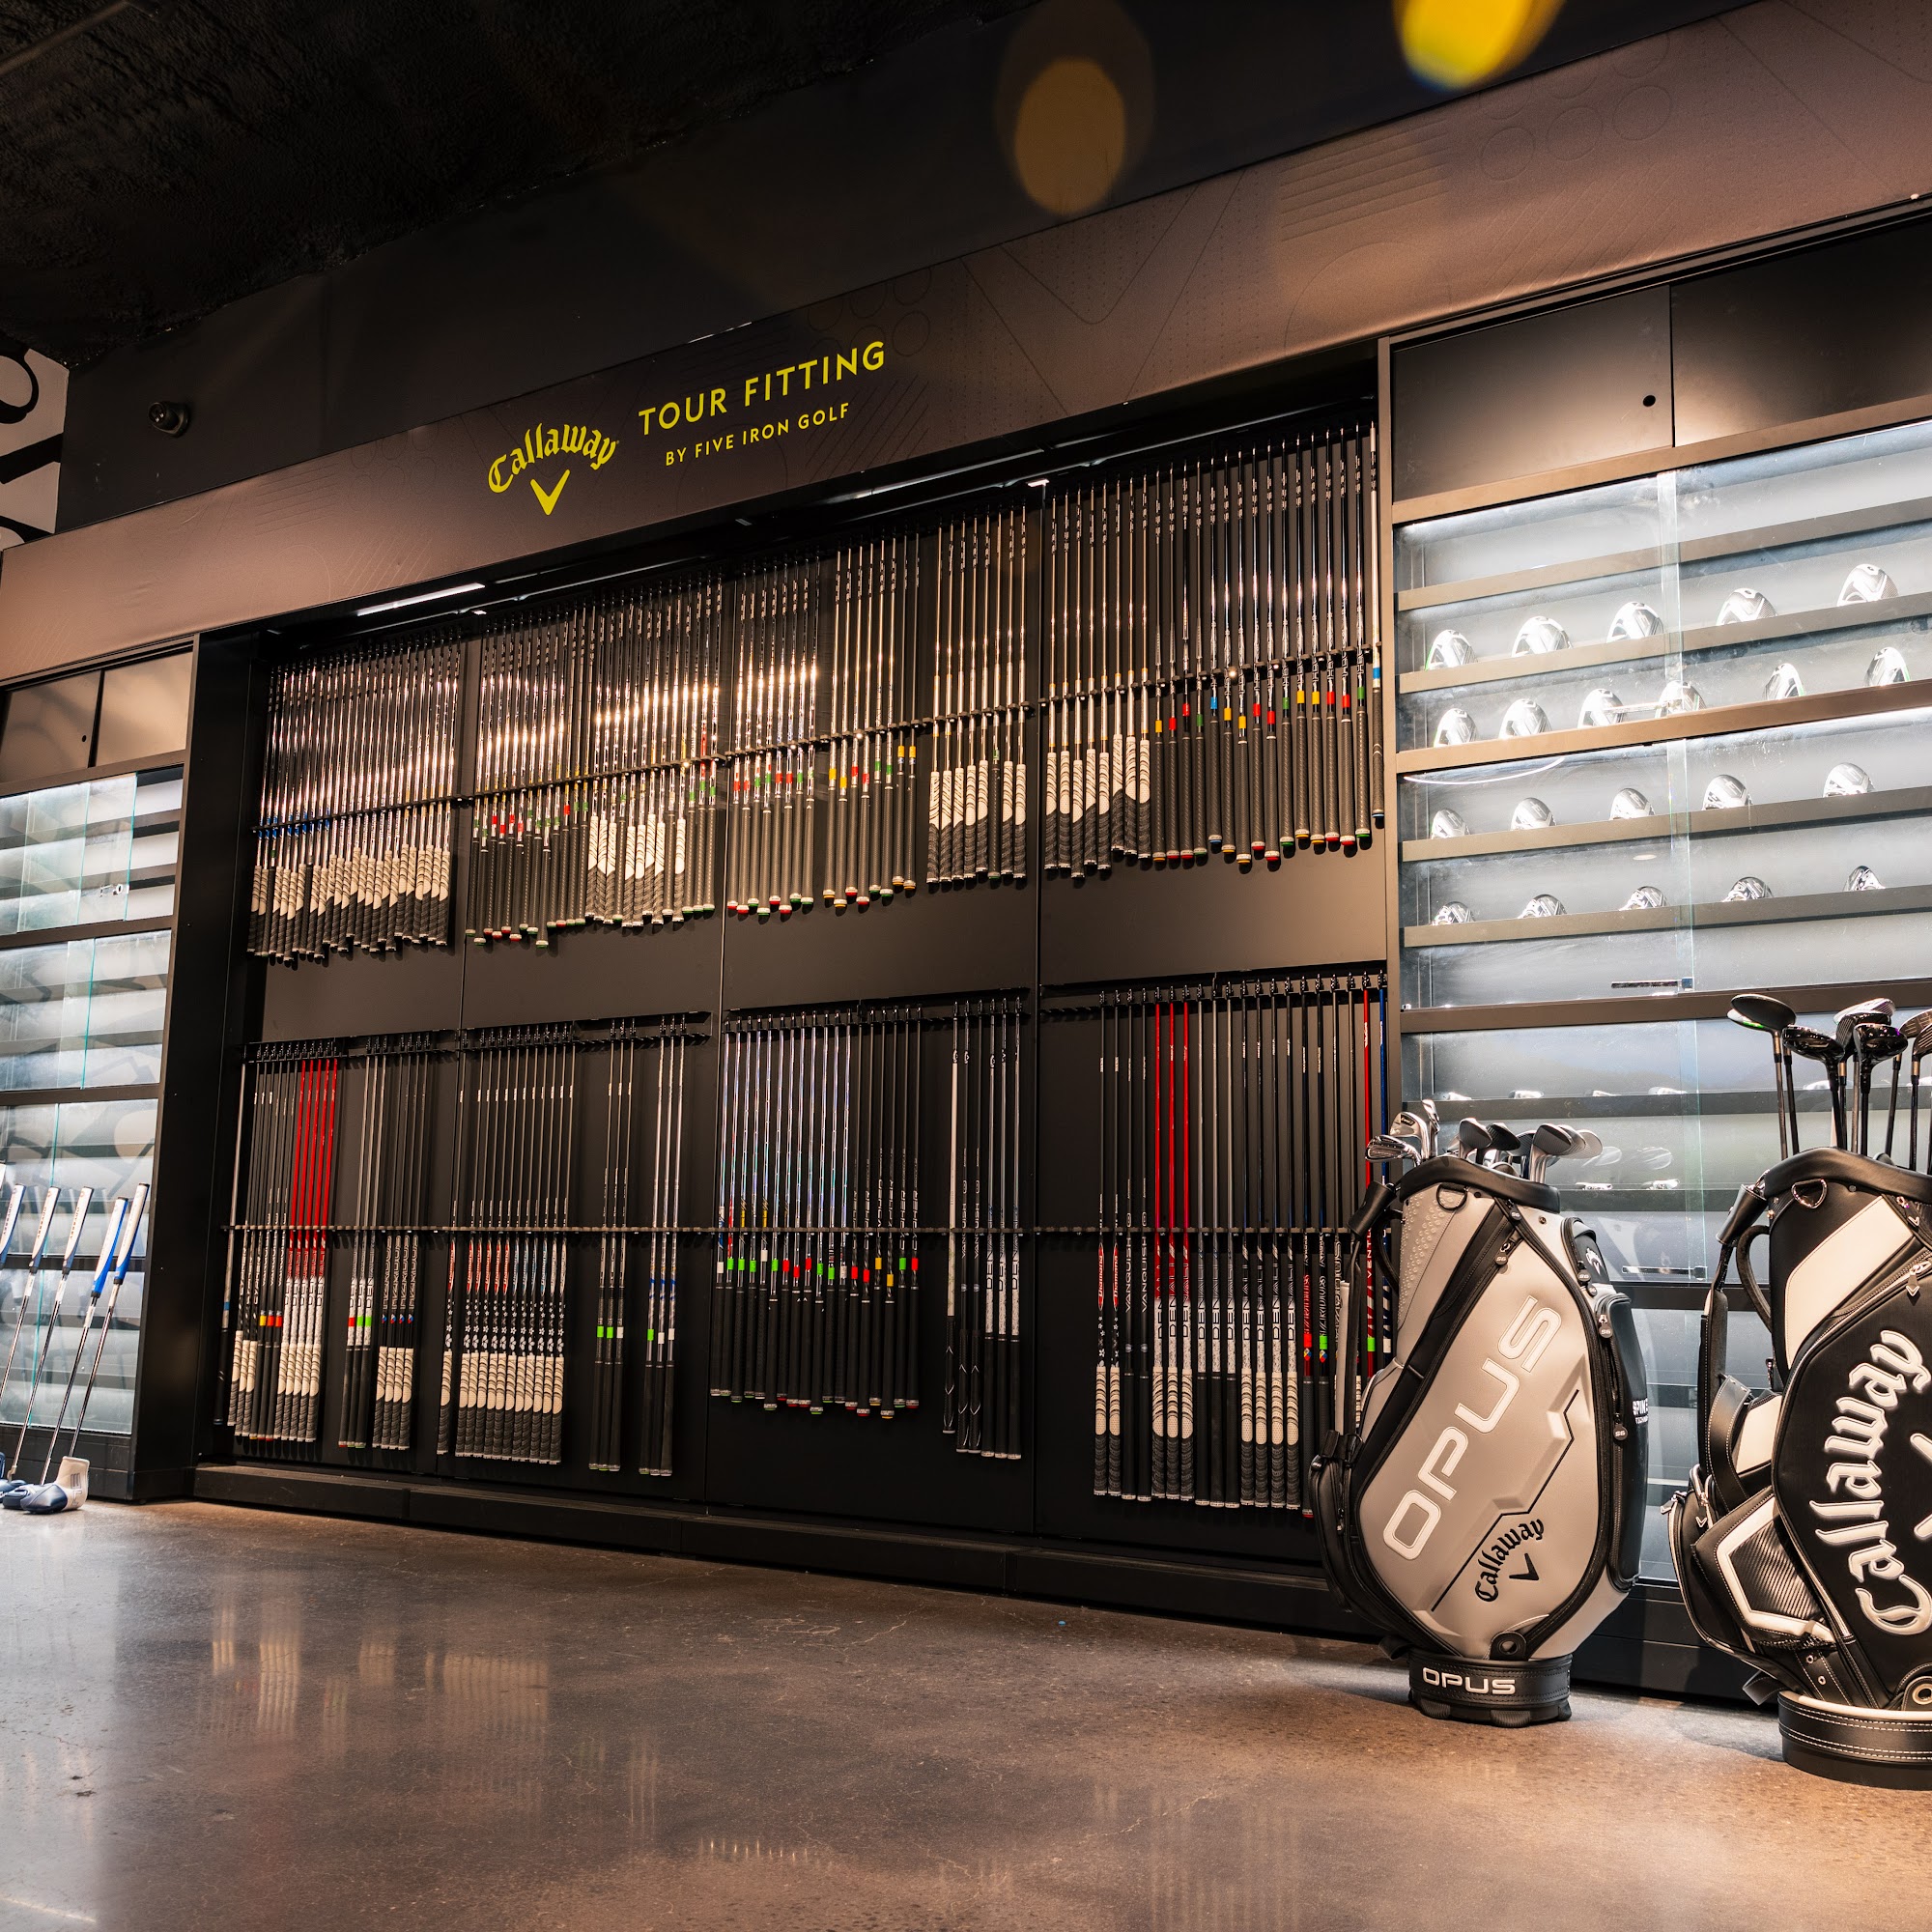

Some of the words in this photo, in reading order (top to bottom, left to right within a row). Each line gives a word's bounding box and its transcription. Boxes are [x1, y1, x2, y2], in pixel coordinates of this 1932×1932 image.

[638, 387, 727, 436] TOUR
[744, 341, 886, 407] FITTING
[488, 422, 617, 494] Callaway
[666, 447, 687, 467] BY
[695, 434, 735, 459] FIVE
[742, 418, 790, 445] IRON
[798, 402, 850, 431] GOLF
[1383, 1294, 1562, 1561] OPUS
[1807, 1329, 1932, 1635] Callaway
[1474, 1518, 1546, 1603] Callaway
[1422, 1666, 1516, 1695] OPUS
